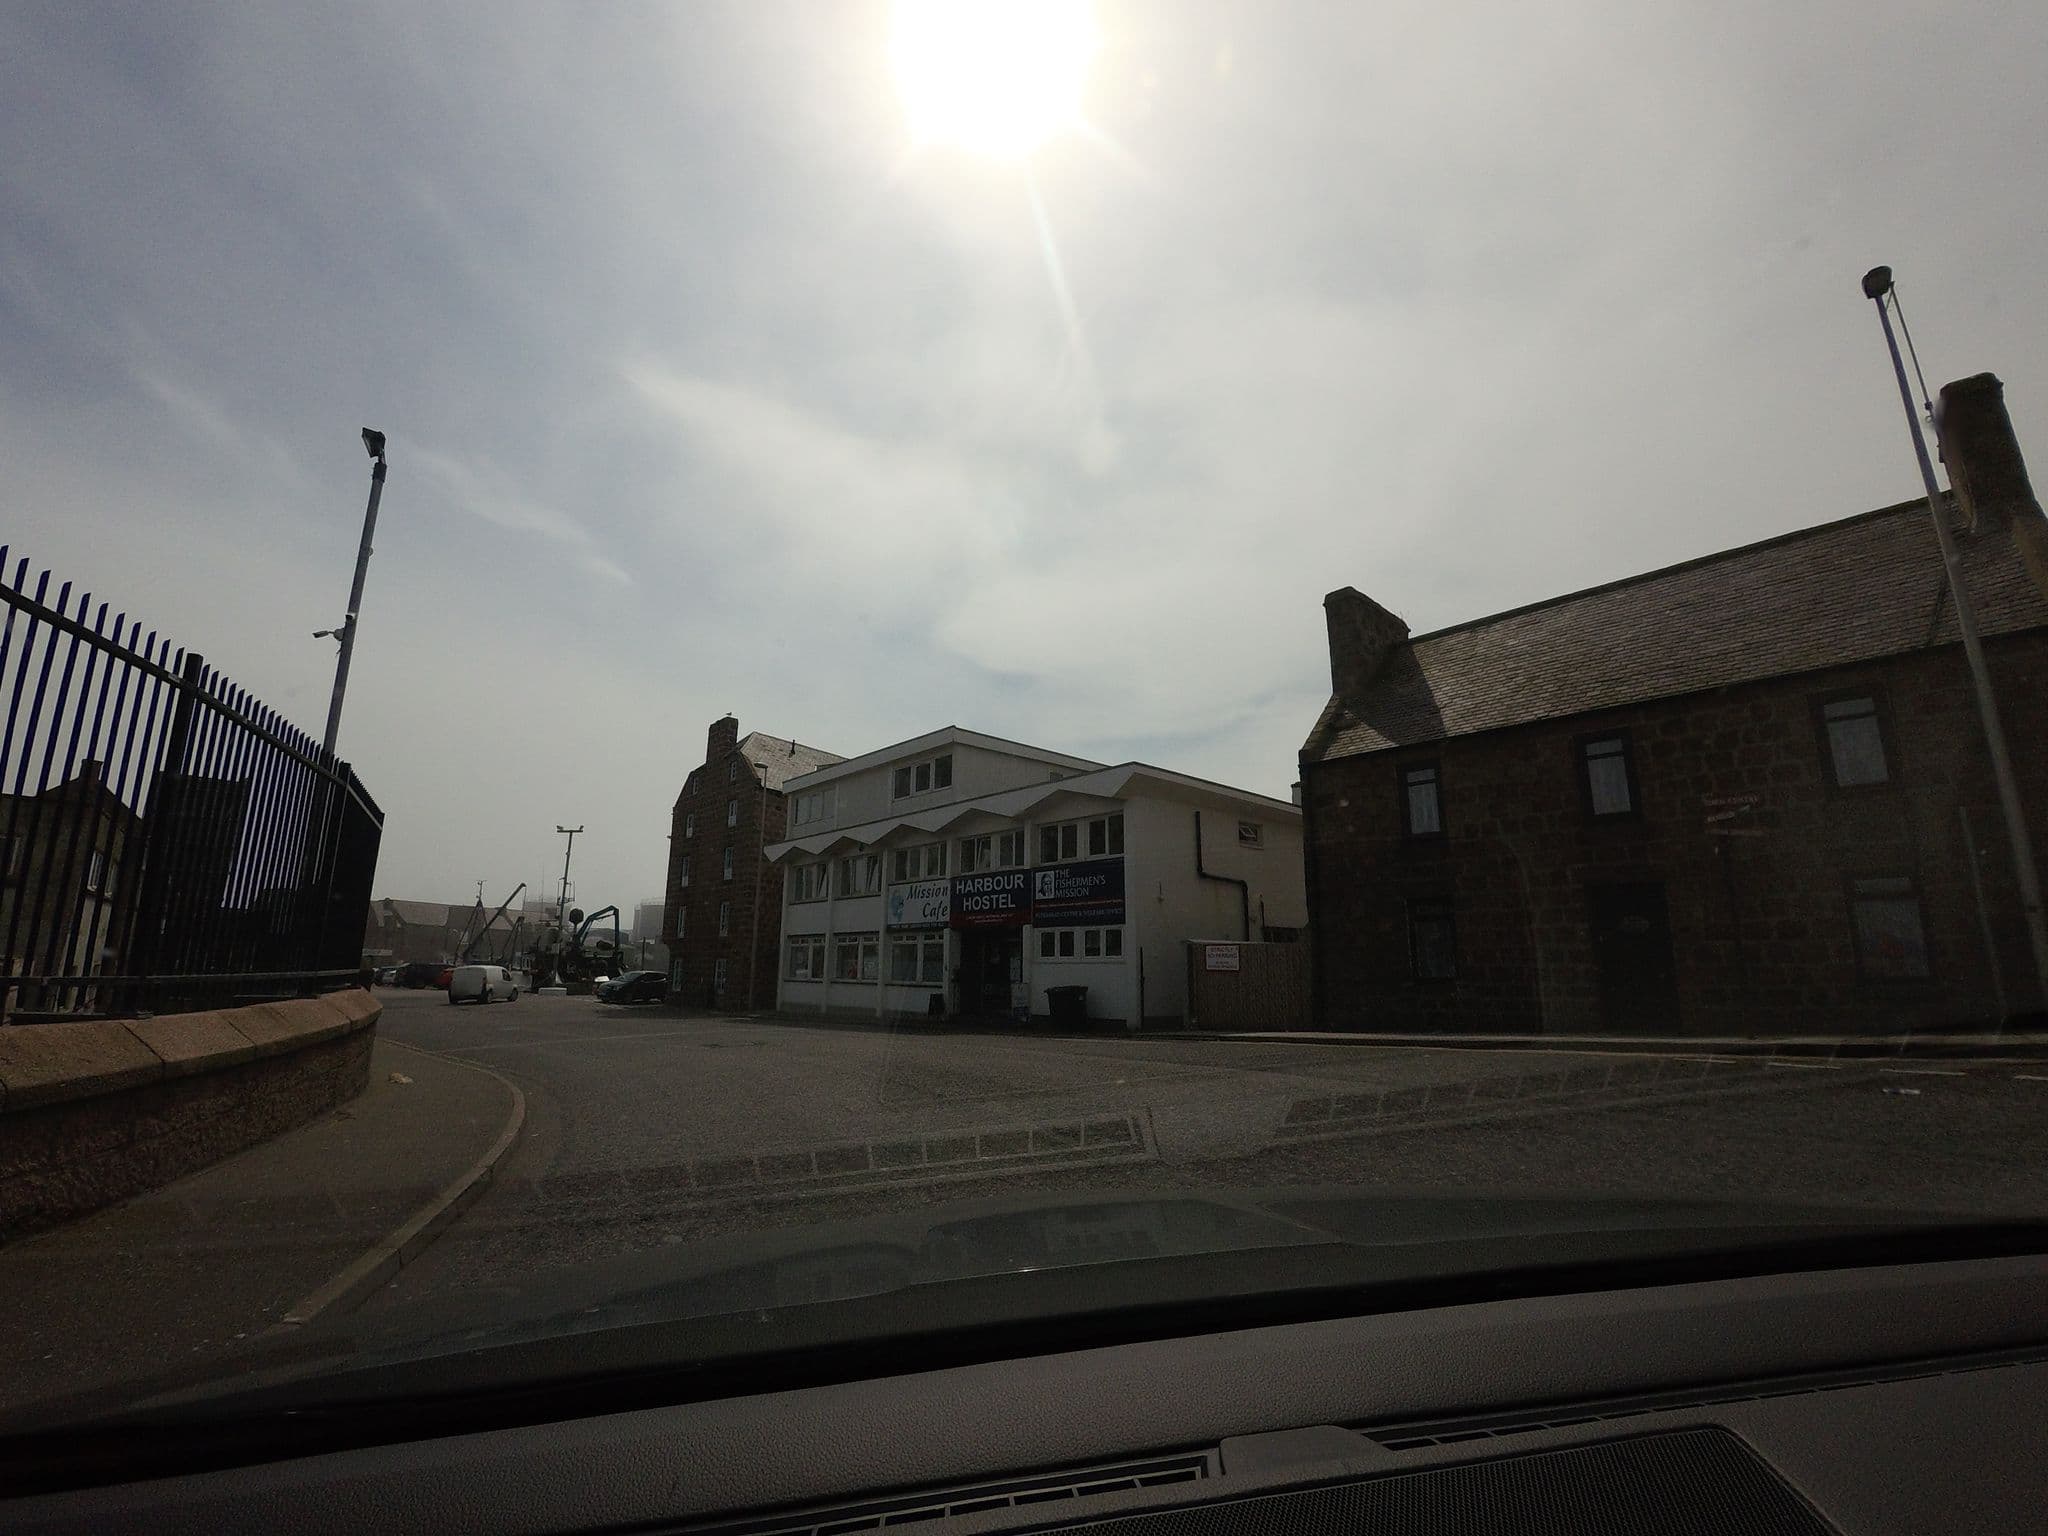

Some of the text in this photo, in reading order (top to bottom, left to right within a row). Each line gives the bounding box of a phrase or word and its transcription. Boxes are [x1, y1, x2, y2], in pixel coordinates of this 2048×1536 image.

[1055, 868, 1070, 878] THE
[906, 883, 949, 901] Mission
[956, 873, 1024, 895] HARBOUR
[1055, 887, 1089, 898] MISSION
[922, 901, 949, 920] Cafe
[963, 894, 1016, 912] HOSTEL
